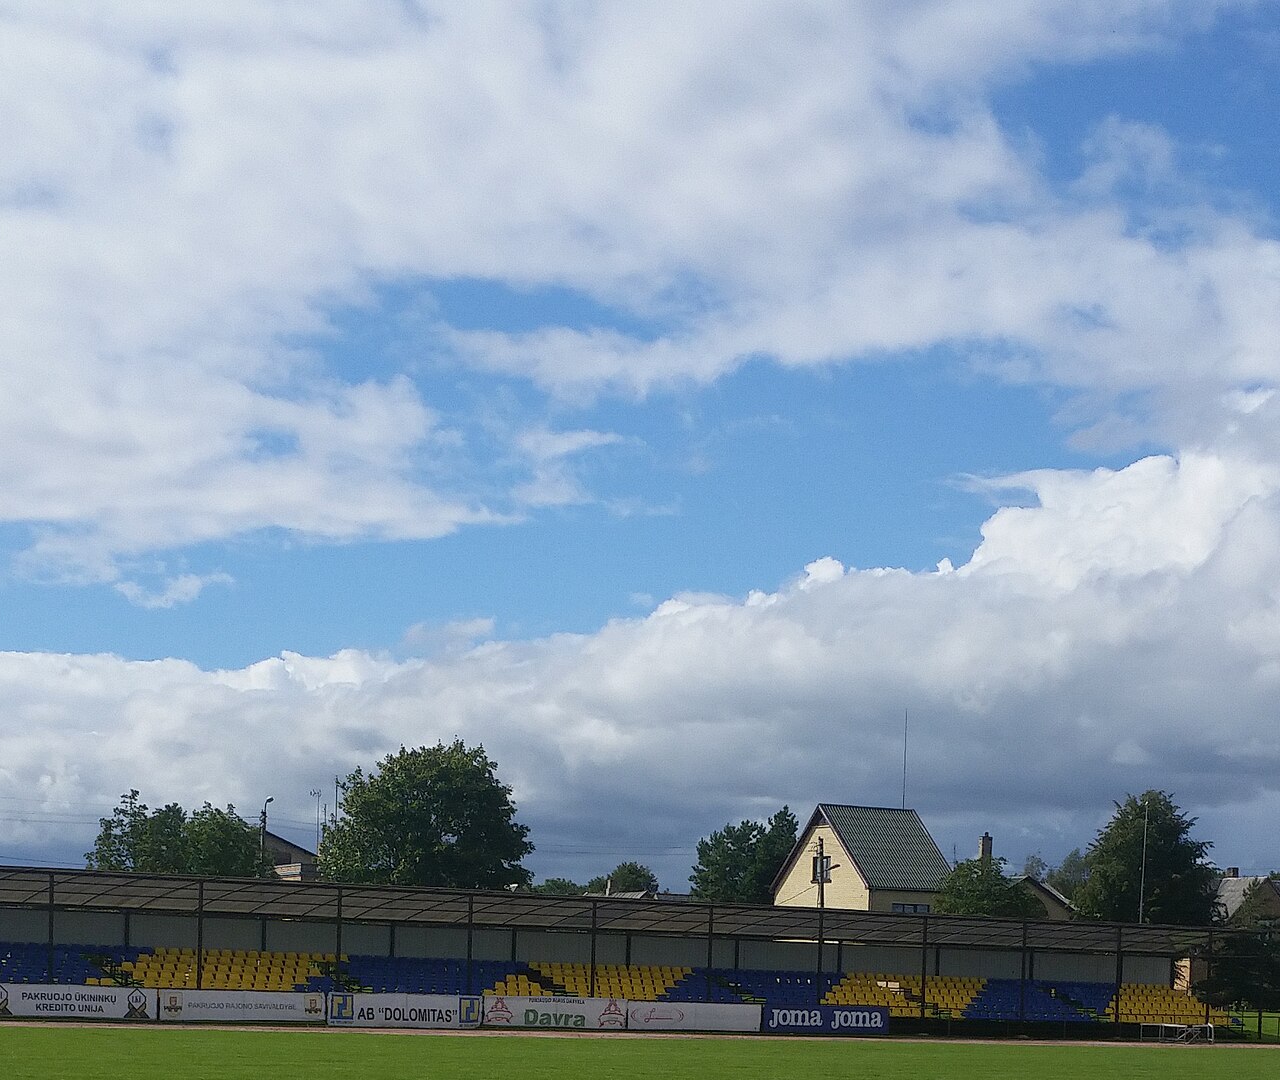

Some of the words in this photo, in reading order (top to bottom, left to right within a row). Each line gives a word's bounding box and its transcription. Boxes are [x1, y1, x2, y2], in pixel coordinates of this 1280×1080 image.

[21, 992, 72, 1001] PAKRUOJO
[35, 1003, 76, 1012] KREDITO
[78, 1004, 104, 1013] UNIJA
[357, 1008, 375, 1021] AB
[524, 1009, 586, 1027] Davra
